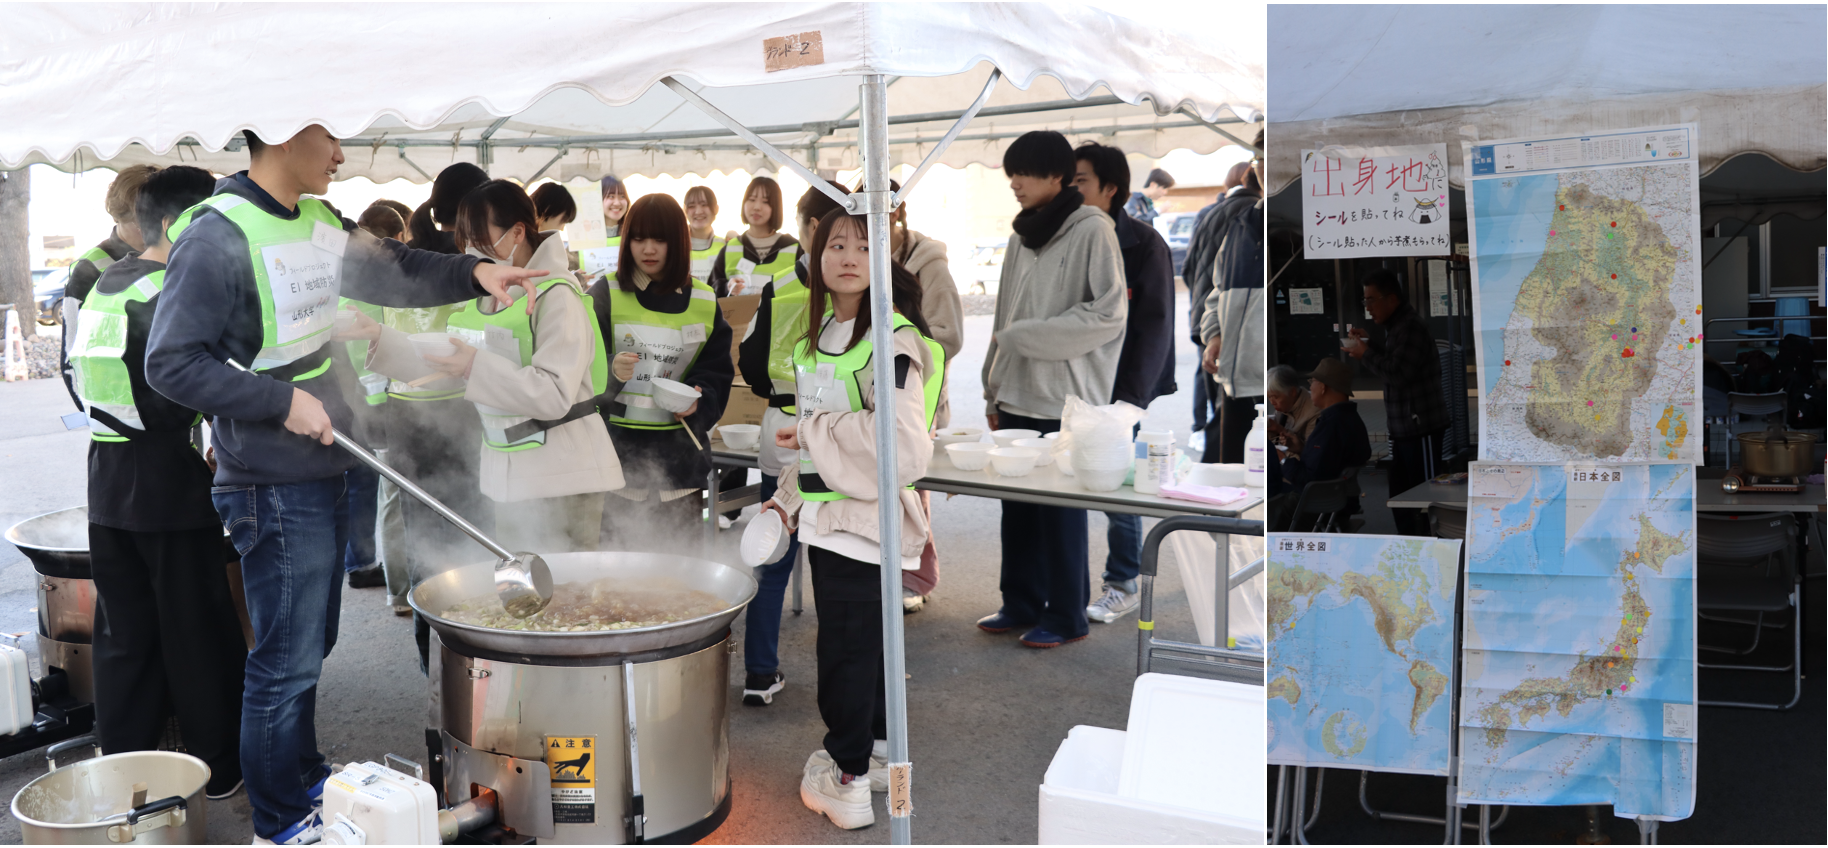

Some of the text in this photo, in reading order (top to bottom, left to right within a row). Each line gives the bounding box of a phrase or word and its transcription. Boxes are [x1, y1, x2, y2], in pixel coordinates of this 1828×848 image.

[800, 42, 809, 55] 2
[1315, 207, 1404, 226] シールを貼ってね
[289, 262, 331, 274] フィールドプロジェクト
[292, 305, 315, 321] 山形大学
[638, 342, 684, 353] フィールドプロジェクト
[1579, 471, 1621, 482] 日本全図
[1284, 541, 1327, 552] 世界全図
[566, 739, 591, 748] 注意
[896, 799, 906, 810] 2
